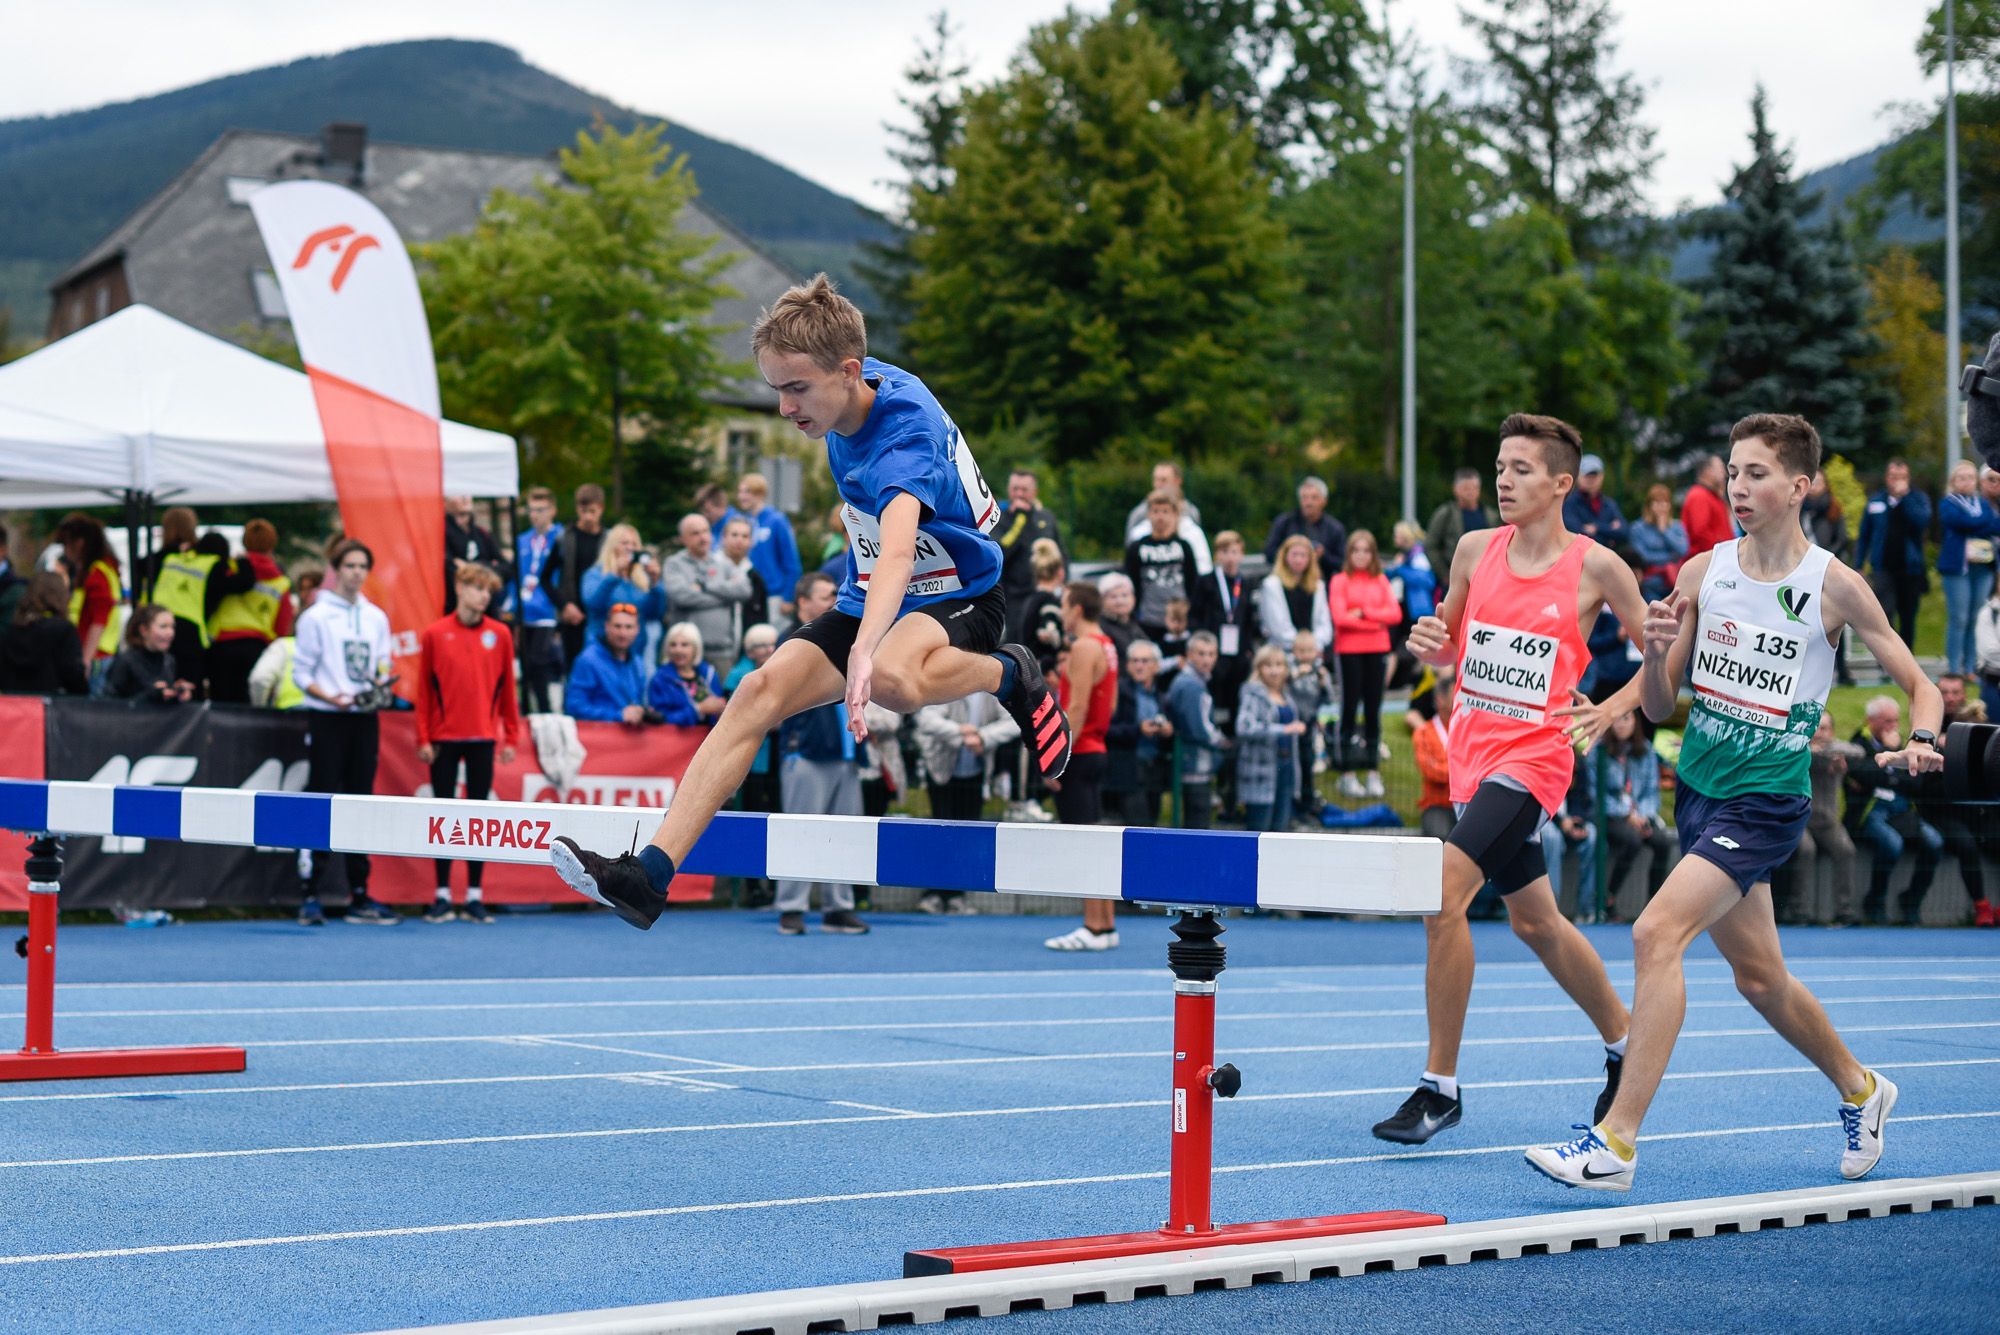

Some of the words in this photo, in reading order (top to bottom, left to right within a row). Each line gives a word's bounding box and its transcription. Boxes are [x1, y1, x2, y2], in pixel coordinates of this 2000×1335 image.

[921, 580, 944, 593] 2021
[1471, 629, 1496, 646] 4F
[1509, 635, 1552, 659] 469
[1708, 630, 1737, 647] ORLEN
[1753, 632, 1799, 660] 135
[1464, 656, 1546, 692] KADŁUCZKA
[1697, 651, 1793, 696] NIŻEWSKI
[1466, 697, 1506, 715] KARPACZ
[1508, 707, 1530, 720] 2021
[1701, 695, 1743, 718] KARPACZ
[1744, 710, 1770, 725] 2021
[428, 816, 551, 850] KARPACZ
